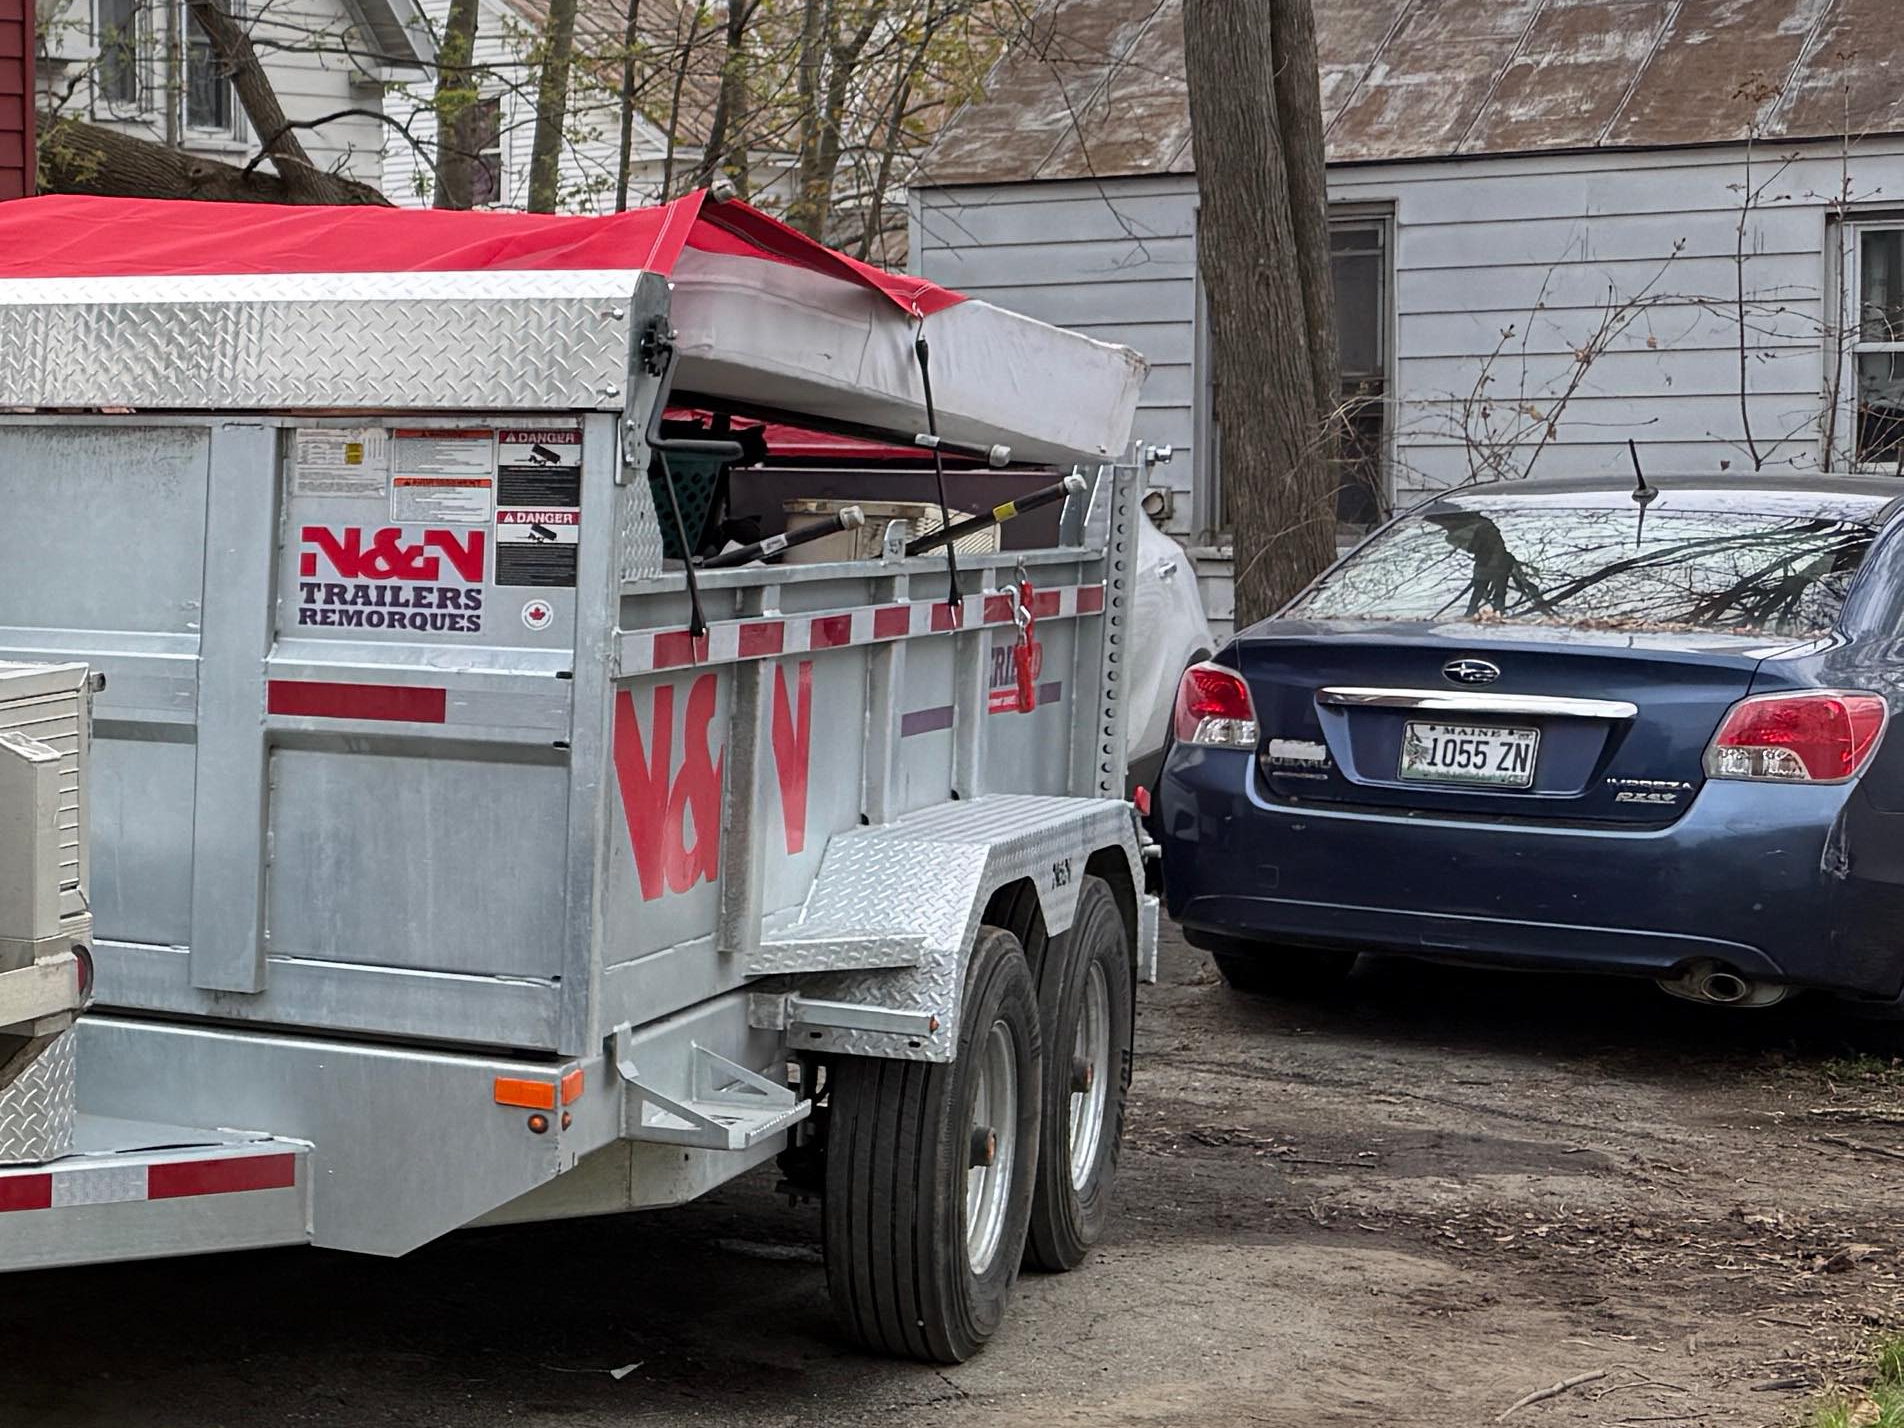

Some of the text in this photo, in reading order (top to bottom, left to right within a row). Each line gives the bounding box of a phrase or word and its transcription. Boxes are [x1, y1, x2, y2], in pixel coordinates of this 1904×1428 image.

[517, 433, 576, 444] DANGER
[516, 512, 574, 524] DANGER
[299, 526, 486, 583] N&N
[299, 581, 483, 610] TRAILERS
[298, 607, 482, 633] REMORQUES
[1442, 726, 1502, 738] MAINE
[1426, 737, 1531, 773] 1055 ZN
